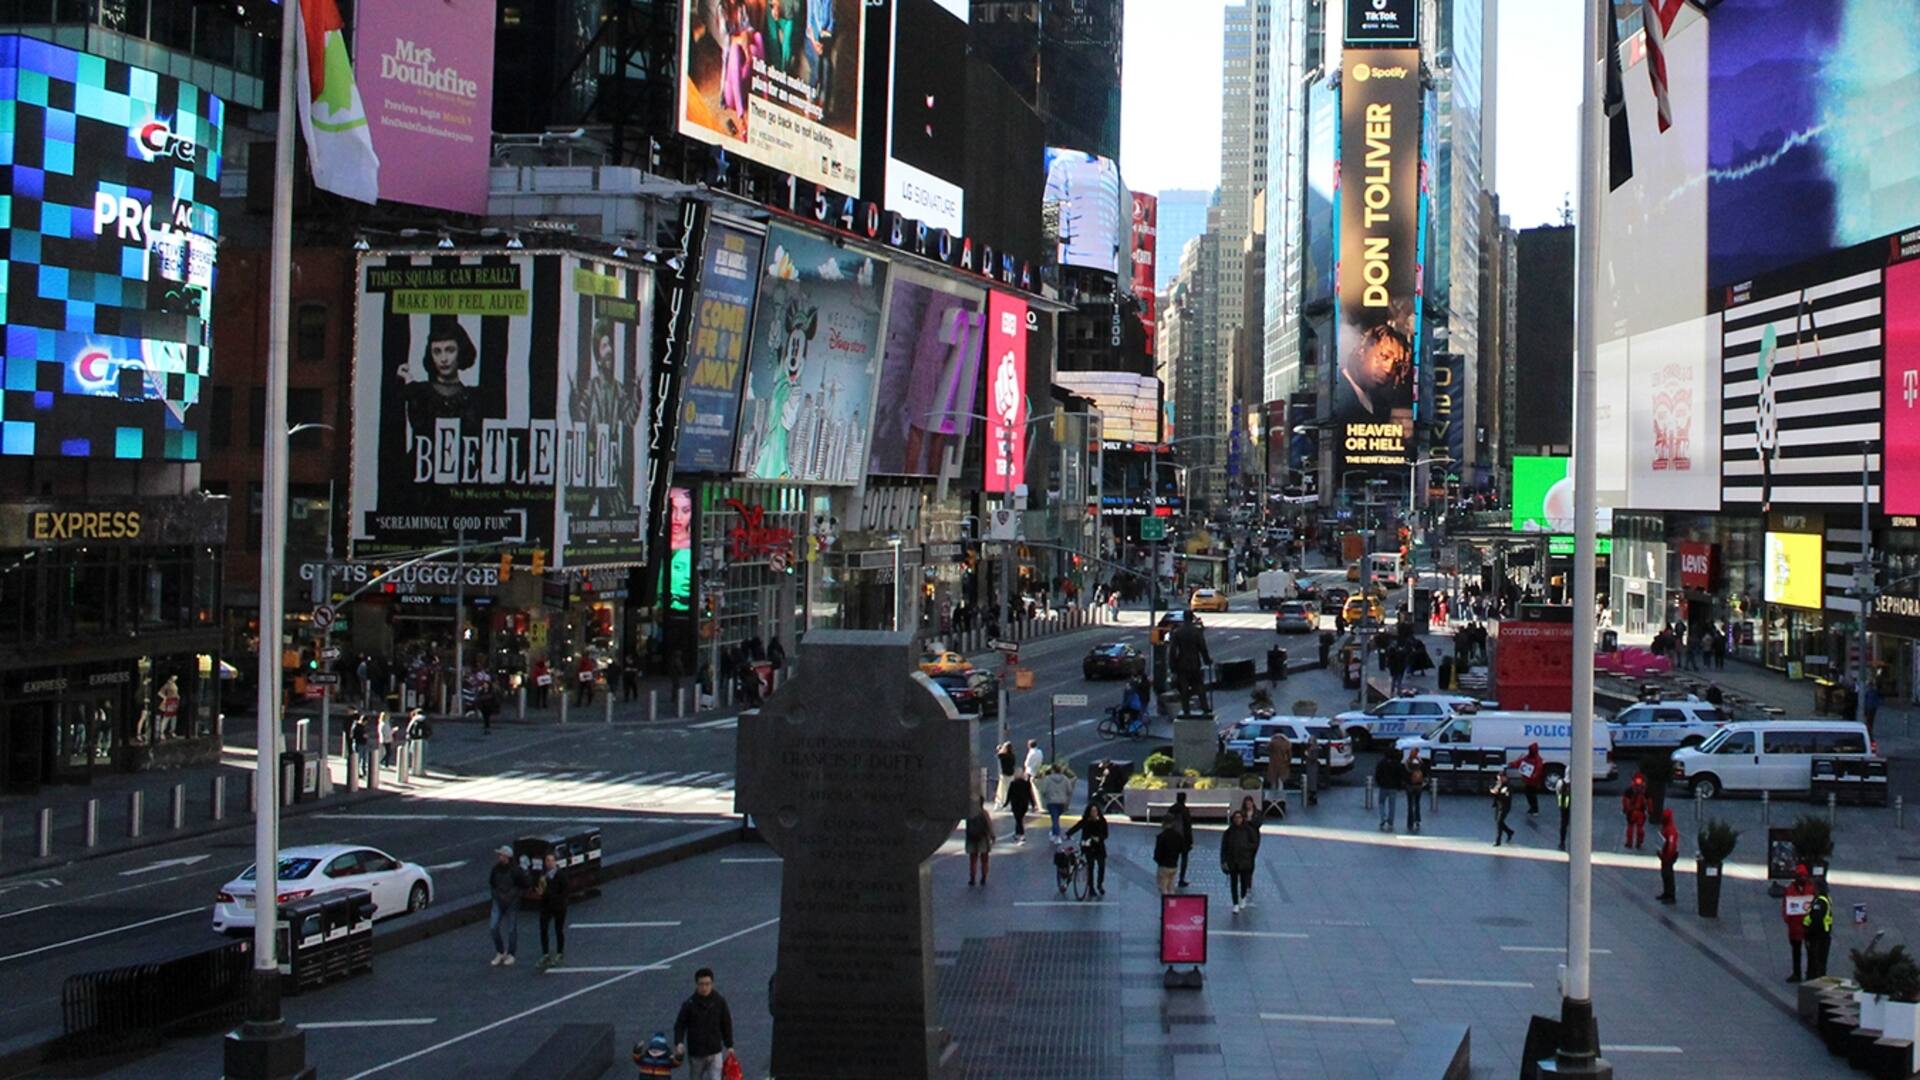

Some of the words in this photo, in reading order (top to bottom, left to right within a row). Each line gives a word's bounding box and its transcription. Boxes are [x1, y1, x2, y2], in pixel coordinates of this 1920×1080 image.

[1364, 11, 1397, 21] TikTok
[396, 38, 436, 66] Mrs.
[380, 54, 477, 98] Doubtfire
[1371, 67, 1408, 79] Spotify
[751, 101, 767, 118] Then
[767, 111, 776, 126] go
[777, 113, 793, 130] back
[793, 120, 801, 133] to
[801, 125, 812, 139] not
[1364, 103, 1392, 233] TOLIVER
[902, 181, 913, 201] LG
[914, 187, 957, 218] SIGNATURE
[370, 271, 402, 287] TIMES
[405, 269, 446, 288] SQUARE
[450, 268, 472, 285] CAN
[475, 267, 517, 285] REALLY
[1363, 243, 1390, 307] DON
[397, 293, 428, 309] MAKE
[432, 293, 454, 309] YOU
[457, 293, 485, 309] FEEL
[488, 293, 525, 309] ALIVE!
[662, 287, 683, 364] MAC
[701, 299, 747, 334] COME
[690, 359, 738, 391] AWAY
[650, 372, 671, 450] MAC
[1346, 423, 1403, 437] HEAVEN
[1345, 438, 1367, 451] OR
[1369, 438, 1405, 451] HELL
[1345, 455, 1360, 464] THE
[1360, 455, 1378, 464] NEW
[34, 511, 141, 540] EXPRESS
[452, 515, 482, 530] GOOD
[401, 595, 433, 604] SONY
[89, 671, 130, 686] EXPRESS
[868, 753, 926, 770] DUFFY
